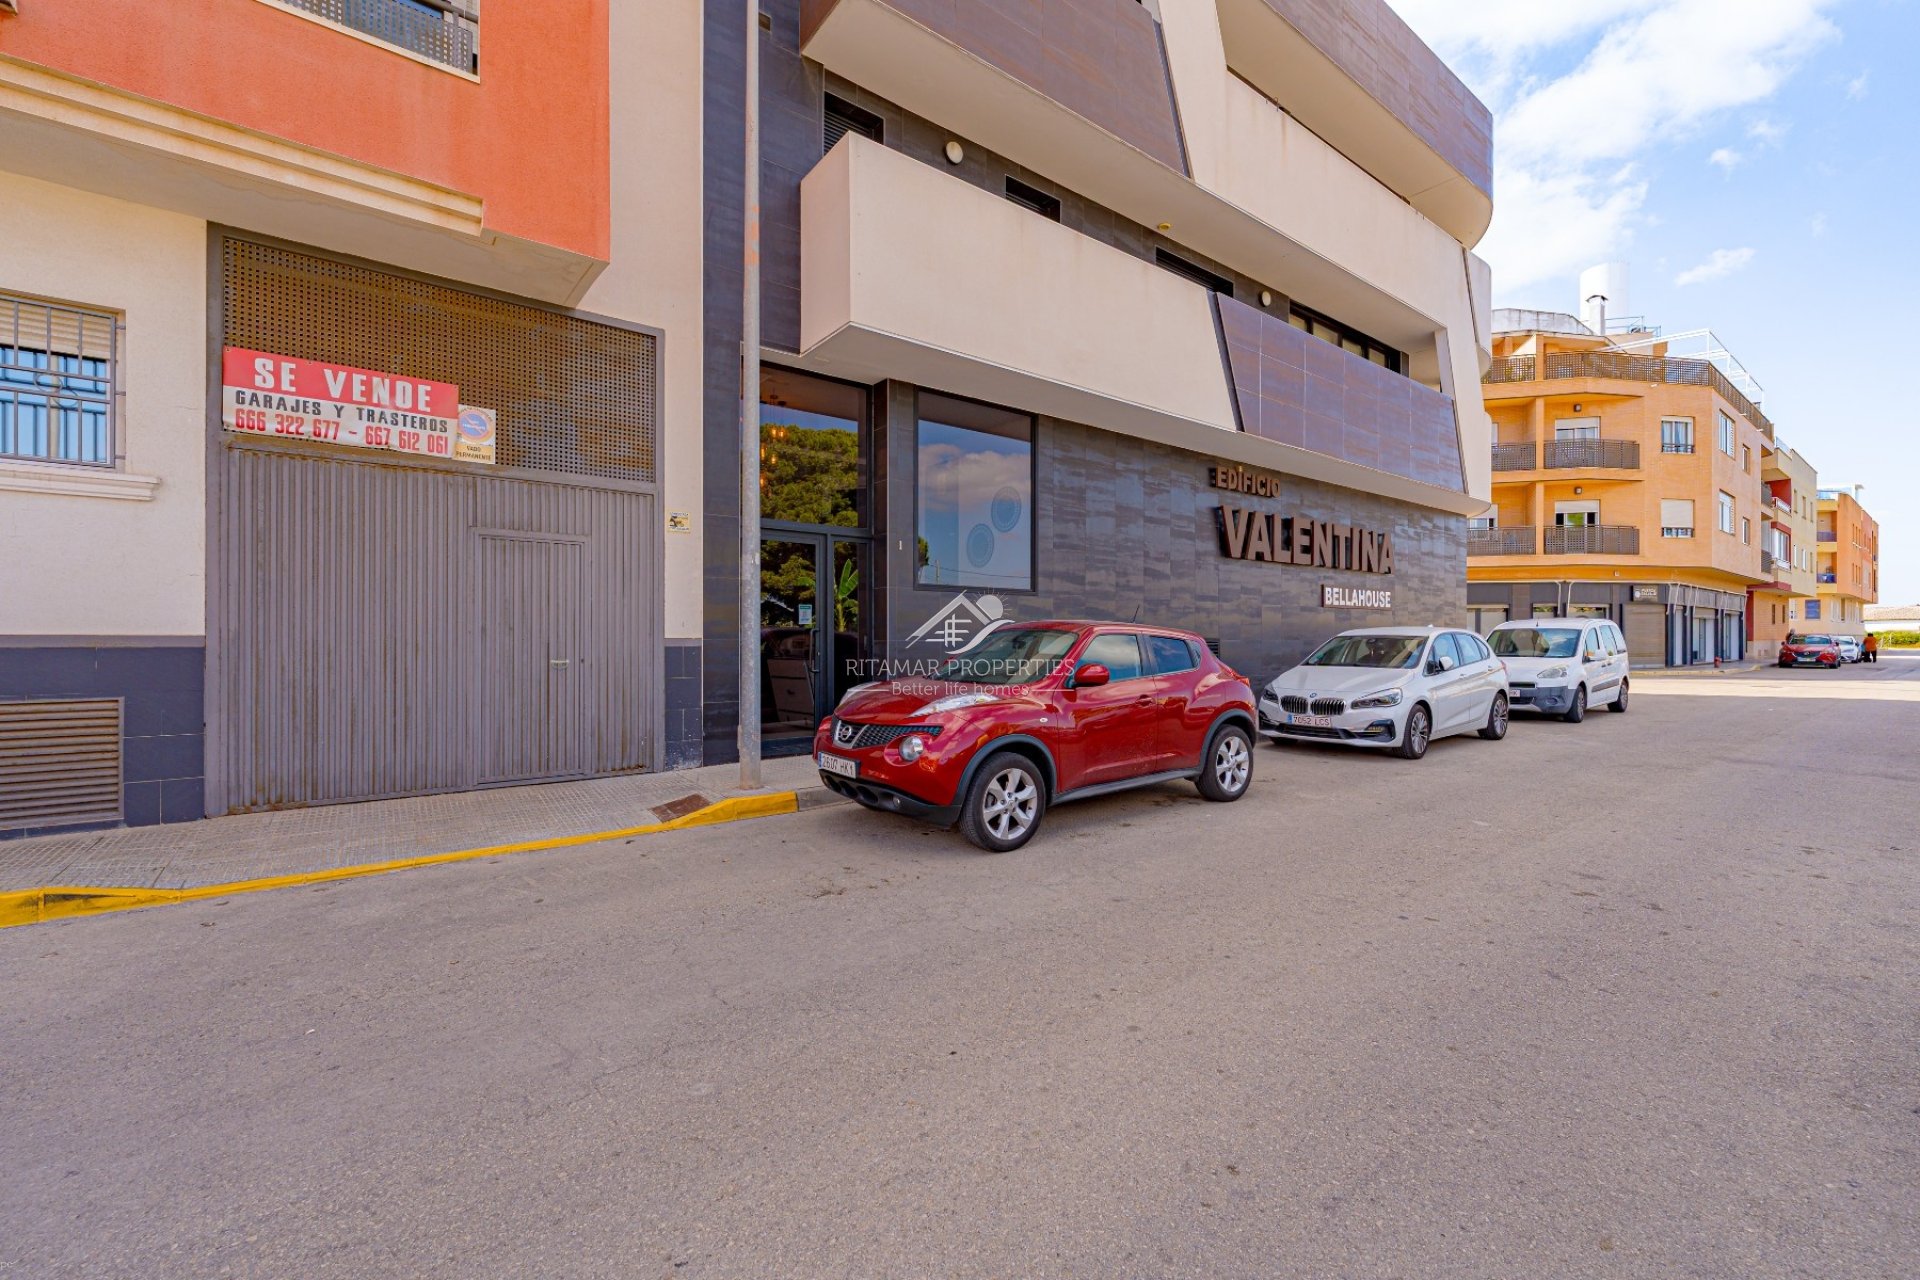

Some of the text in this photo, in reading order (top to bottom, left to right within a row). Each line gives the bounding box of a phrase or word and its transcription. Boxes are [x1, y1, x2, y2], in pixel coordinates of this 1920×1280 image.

[254, 357, 431, 412] SE VENDE
[235, 390, 322, 416] GARAJES
[334, 404, 345, 418] Y
[356, 407, 448, 433] TRASTEROS
[235, 408, 266, 432] 666
[275, 413, 305, 435] 322
[313, 419, 340, 440] 677
[365, 425, 391, 446] 667
[399, 430, 420, 450] 612
[427, 435, 448, 455] 061
[1214, 466, 1281, 497] EDIFICIO
[1219, 505, 1395, 574] VALENTINA
[1325, 587, 1392, 608] BELLAHOUSE
